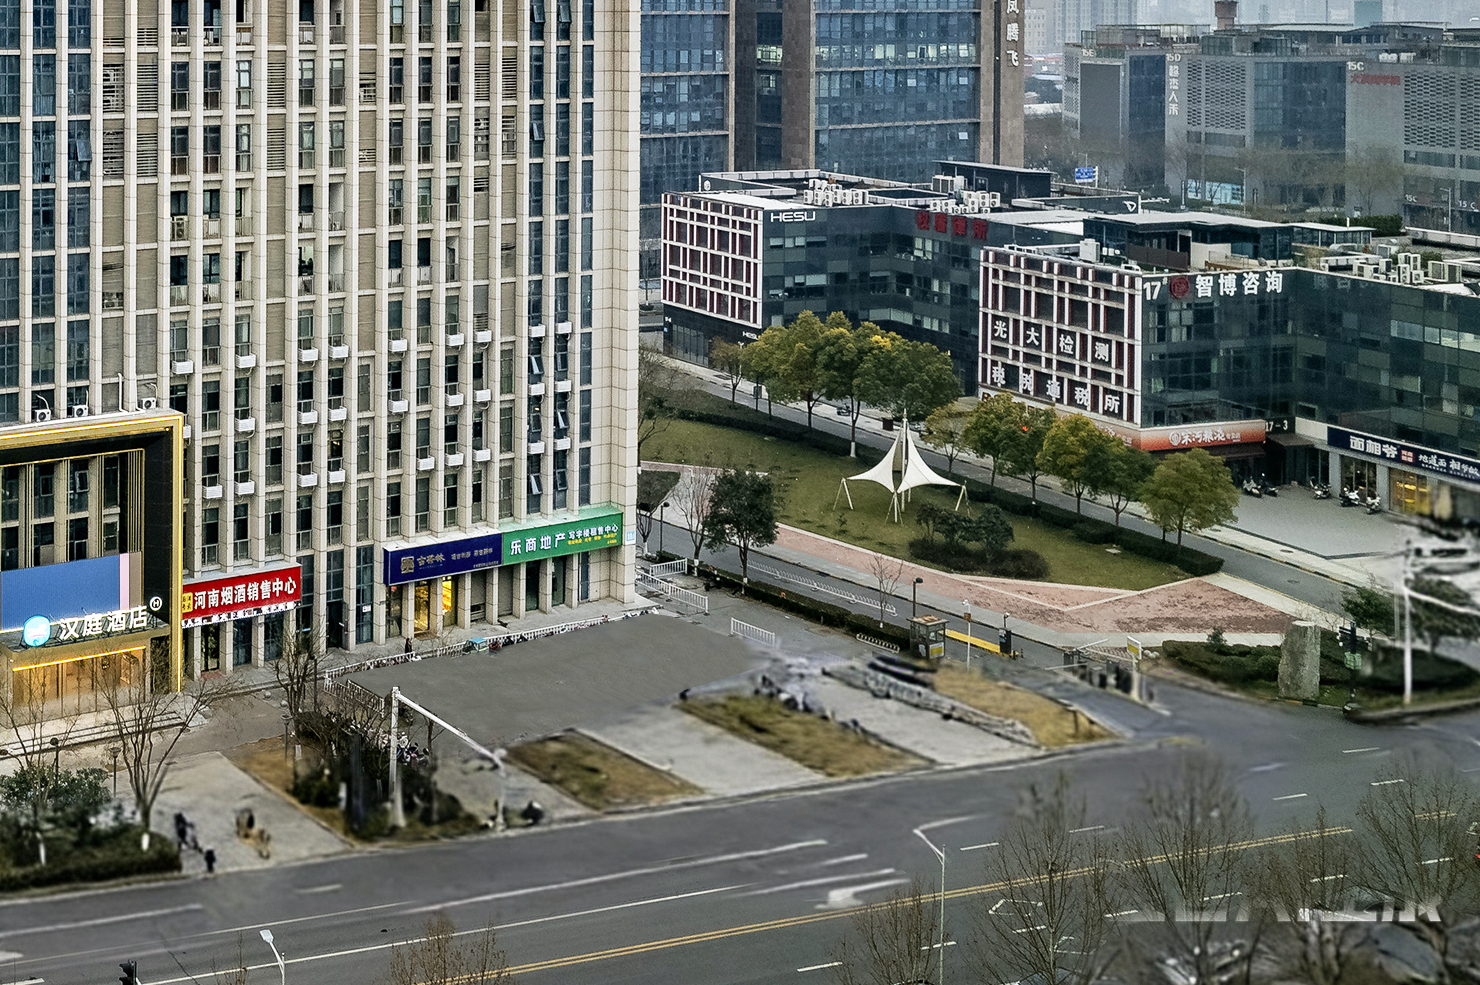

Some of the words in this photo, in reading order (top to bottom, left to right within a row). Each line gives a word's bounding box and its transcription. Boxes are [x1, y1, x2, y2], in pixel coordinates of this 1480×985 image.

[1346, 61, 1365, 71] 15C
[770, 211, 816, 222] HESU
[1196, 271, 1283, 298] 智博咨询
[993, 320, 1110, 362] 光大检测
[1349, 435, 1398, 459] 面相爷
[510, 533, 566, 555] 乐商地产
[568, 524, 619, 540] 写字楼租售中心
[194, 577, 297, 610] 河南烟酒销售中心
[60, 605, 148, 641] 汉庭酒店
